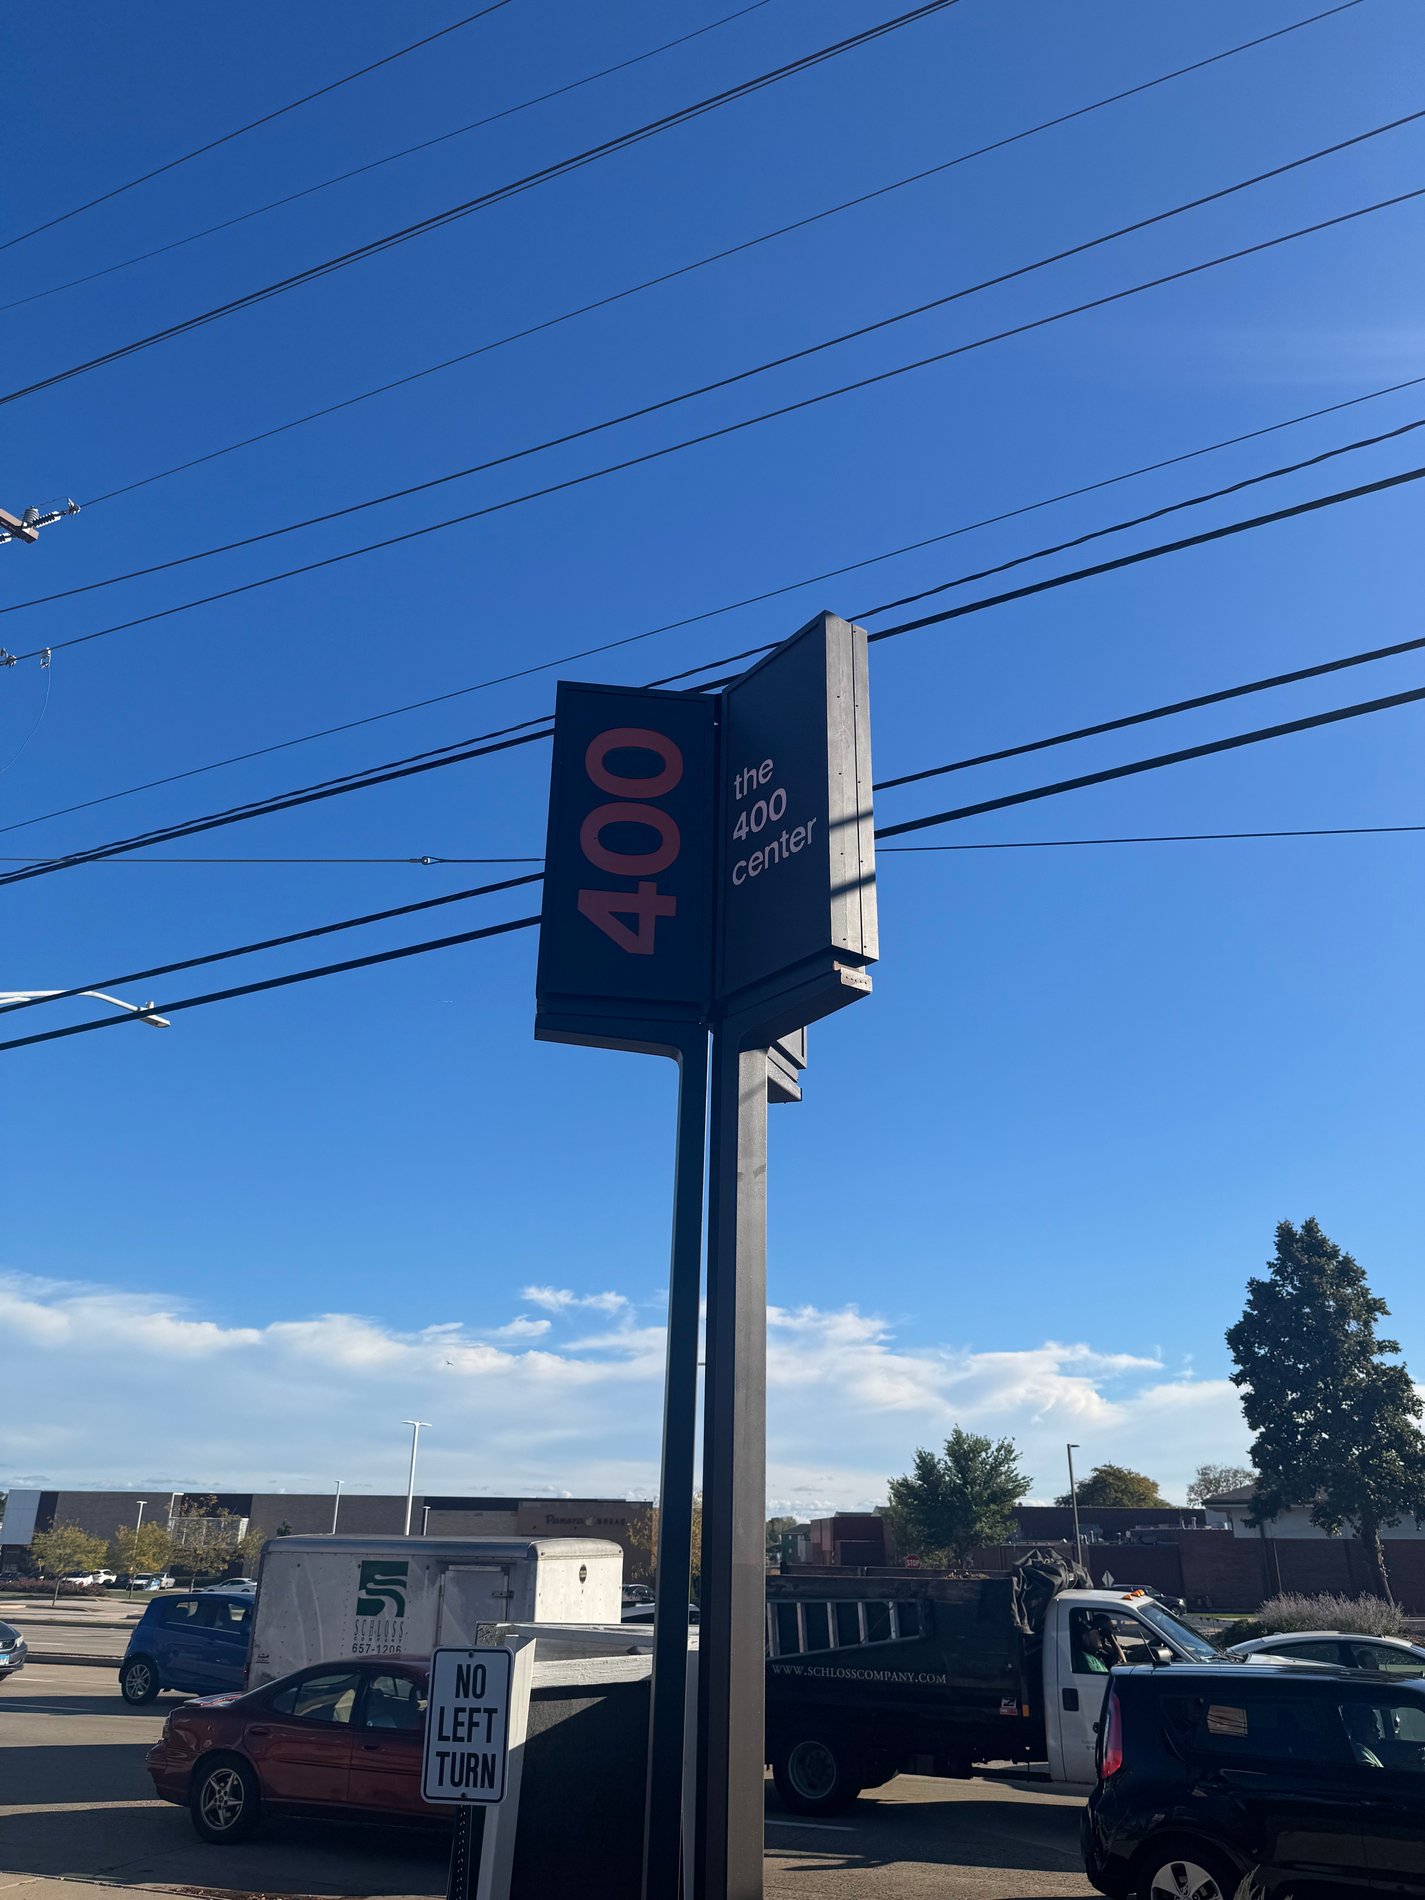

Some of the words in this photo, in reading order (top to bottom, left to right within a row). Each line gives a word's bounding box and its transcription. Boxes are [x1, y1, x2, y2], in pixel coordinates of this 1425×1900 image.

[733, 758, 774, 801] the
[732, 787, 787, 841] 400
[577, 727, 684, 956] 400
[732, 816, 817, 887] center
[906, 1559, 920, 1567] STOP
[353, 1618, 404, 1638] SCHLOSS
[352, 1642, 402, 1654] 657-1206
[455, 1663, 487, 1699] NO
[772, 1664, 947, 1684] WWW.SCHLOSSCOMPANY.COM
[437, 1706, 499, 1744] LEFT
[435, 1751, 497, 1789] TURN
